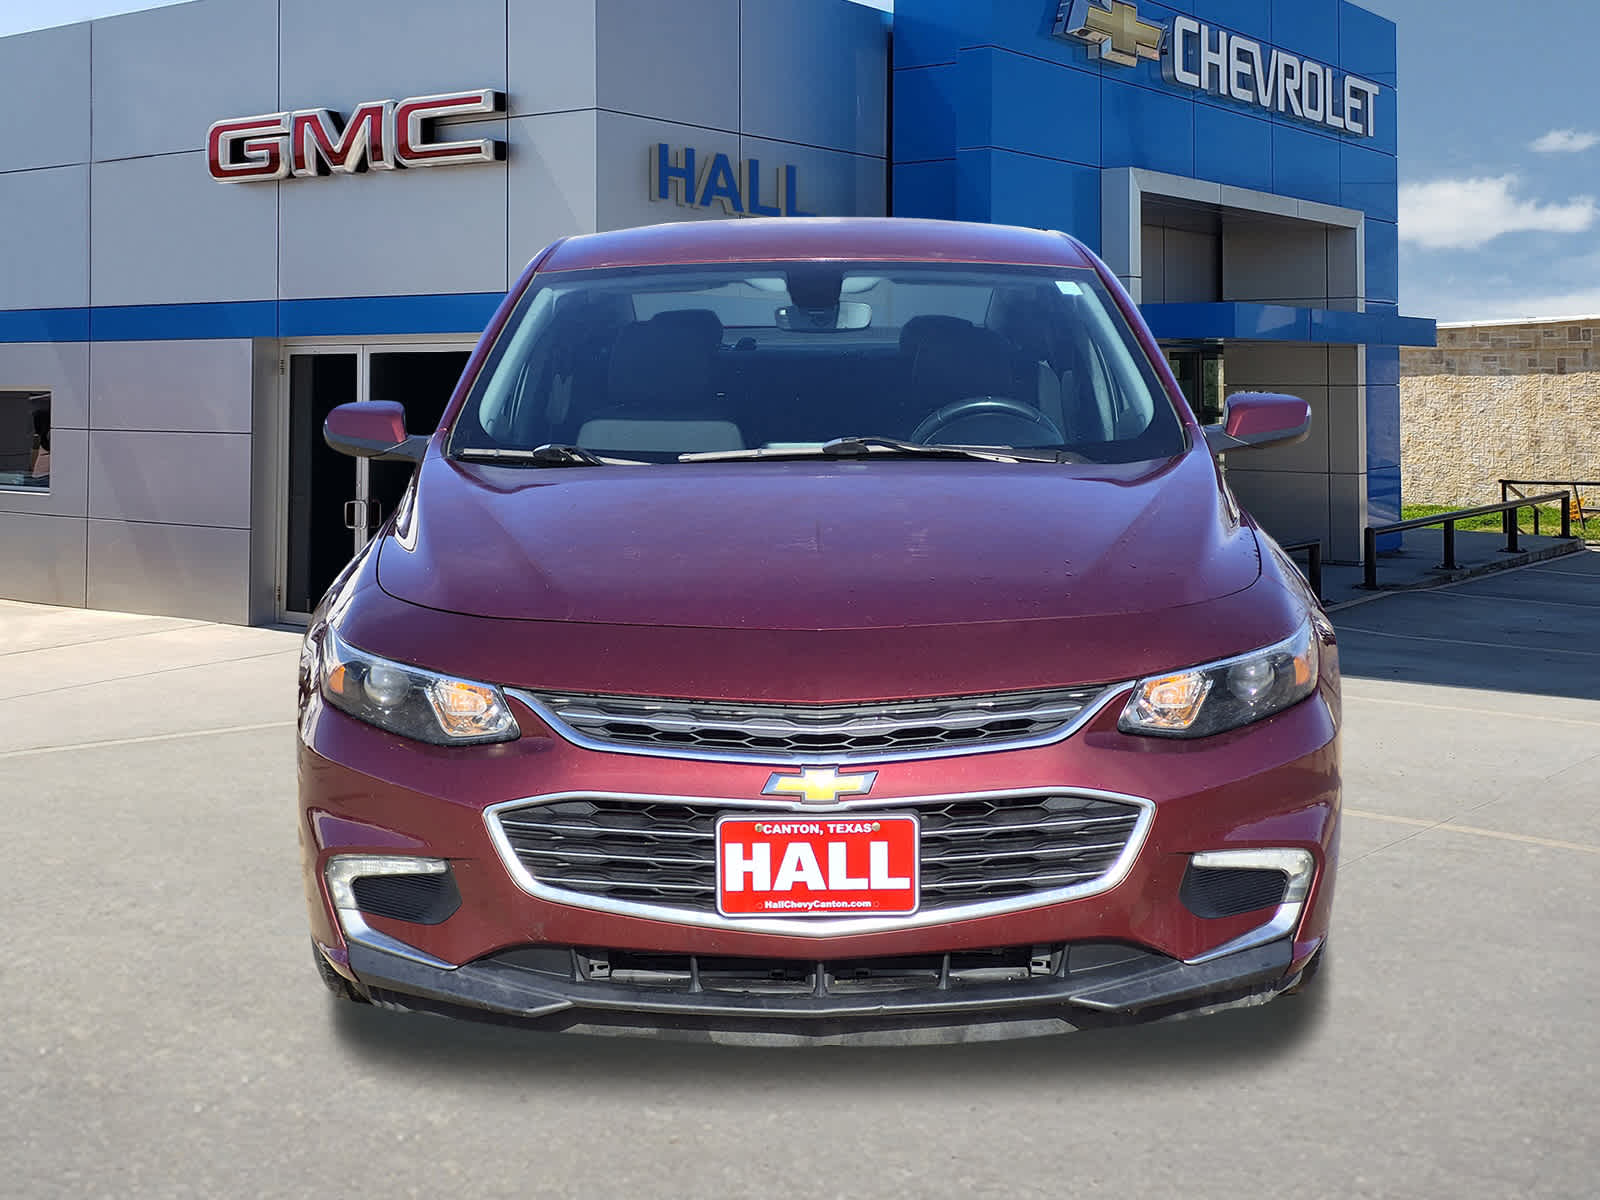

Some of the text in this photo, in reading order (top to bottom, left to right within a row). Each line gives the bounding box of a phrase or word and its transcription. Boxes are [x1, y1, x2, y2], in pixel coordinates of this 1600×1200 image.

[1174, 15, 1380, 138] CHEVROLET
[207, 88, 500, 184] GMC
[651, 143, 818, 217] HALL
[763, 823, 873, 836] CANTON, TEXAS
[724, 840, 911, 892] HALL
[764, 899, 872, 910] HallChevyCanton.com
